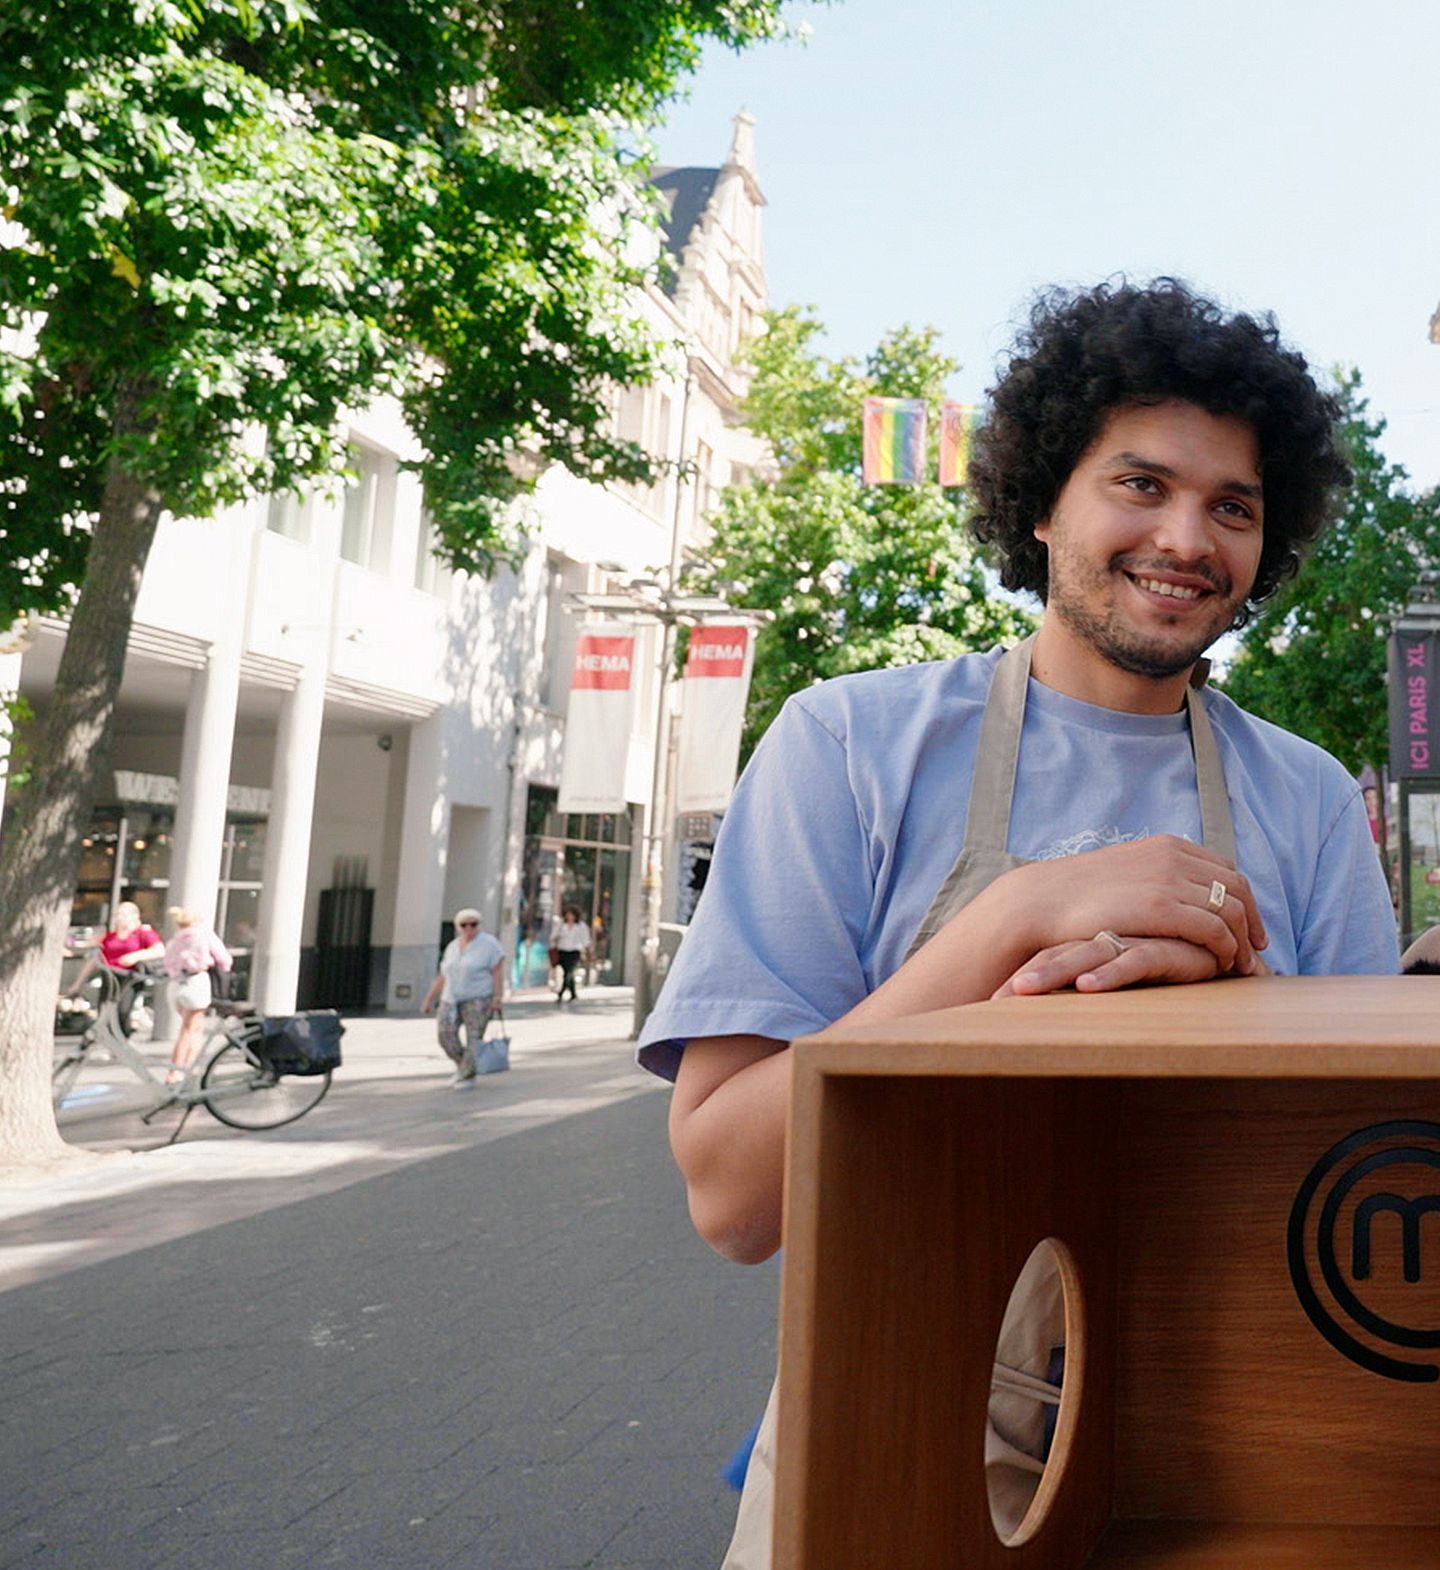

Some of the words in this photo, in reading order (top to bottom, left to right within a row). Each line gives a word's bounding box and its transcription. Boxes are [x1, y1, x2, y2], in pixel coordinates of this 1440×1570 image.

[575, 654, 630, 672] HEMA
[690, 643, 744, 661] HEMA
[1406, 643, 1425, 667] XL
[1408, 675, 1428, 734] PARIS
[1410, 740, 1429, 769] ICI
